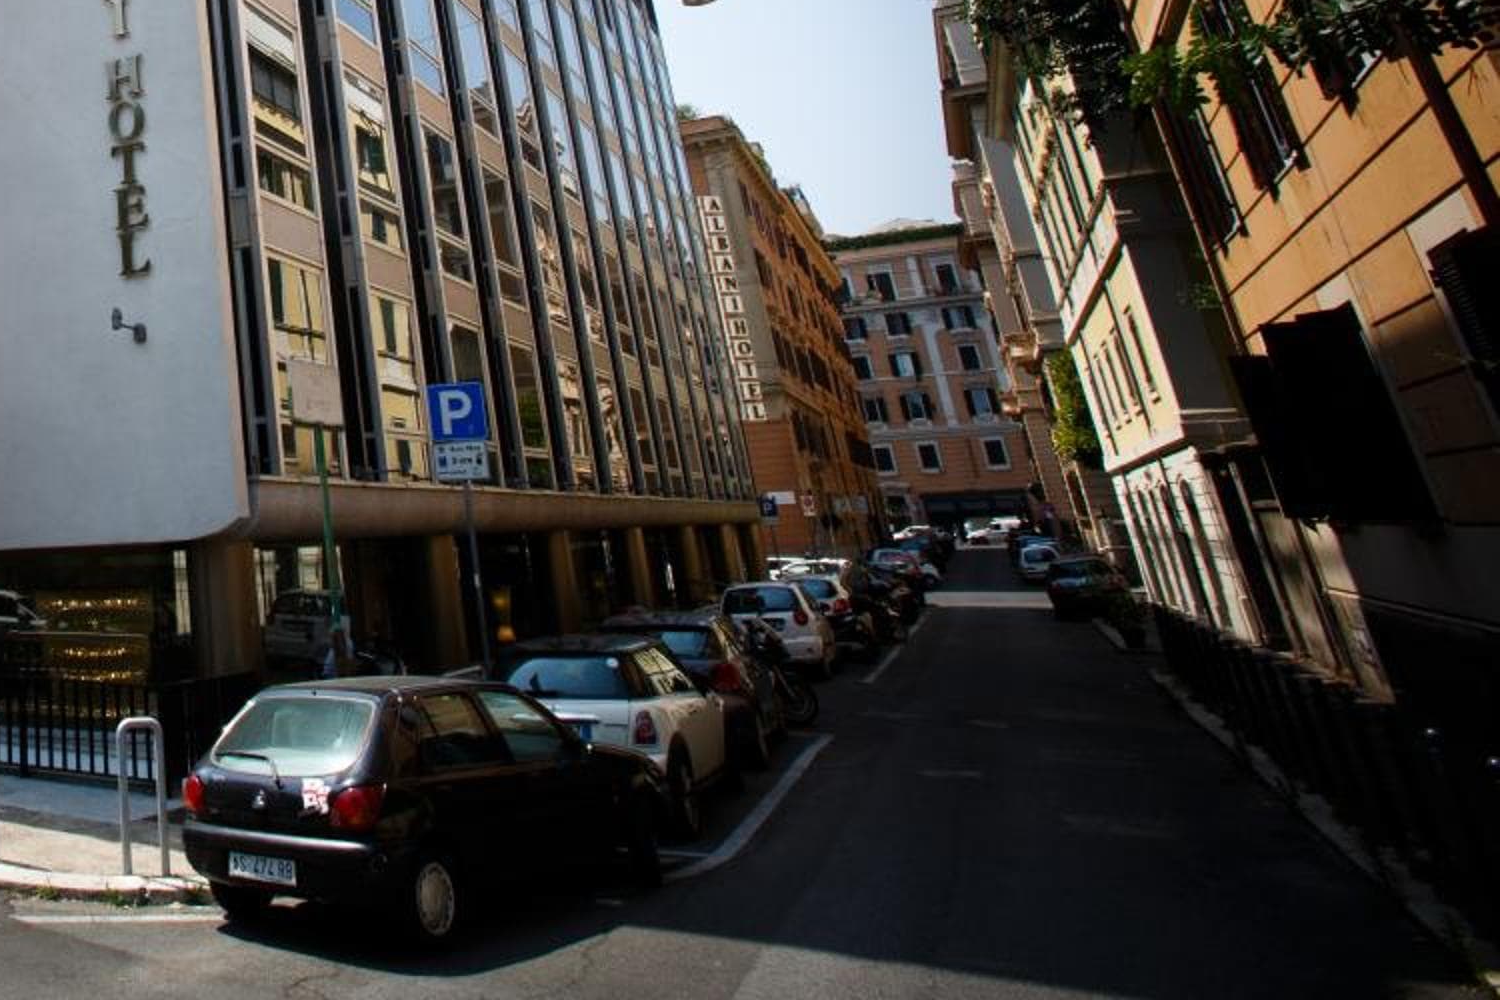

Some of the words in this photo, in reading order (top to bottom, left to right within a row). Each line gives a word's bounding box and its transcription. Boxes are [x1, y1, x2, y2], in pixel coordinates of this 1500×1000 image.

[105, 53, 151, 278] HOTEL
[438, 389, 472, 435] P
[709, 199, 739, 311] ALBANI
[734, 320, 765, 419] HOTEL
